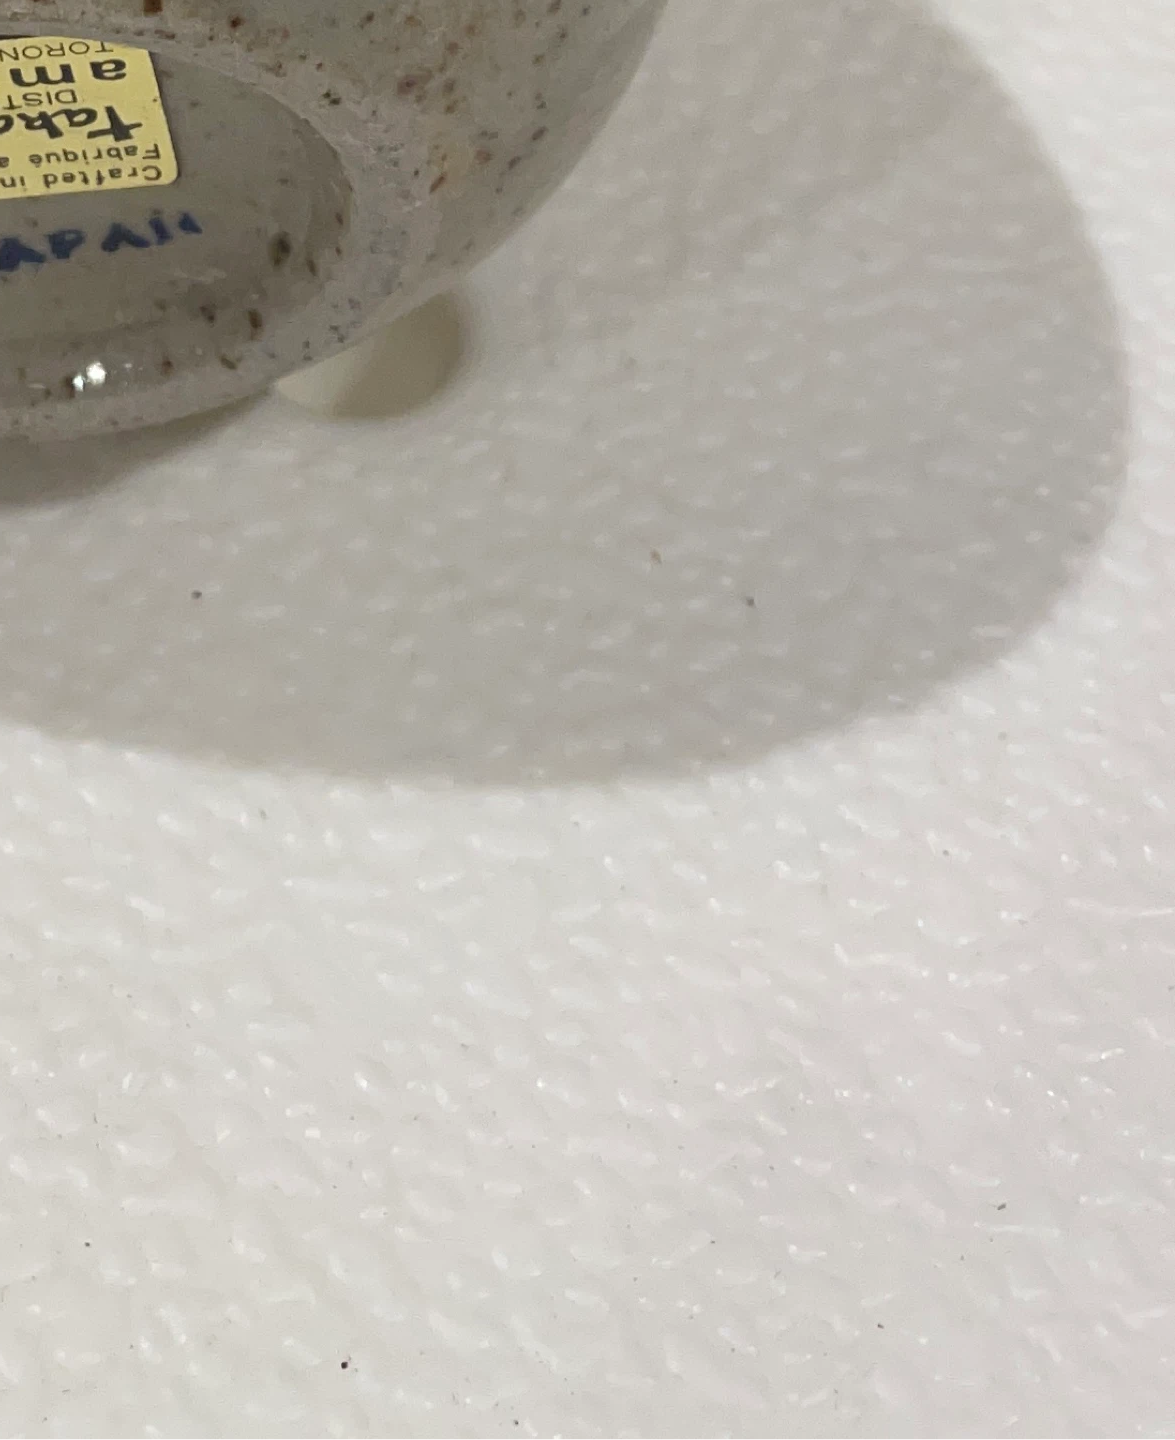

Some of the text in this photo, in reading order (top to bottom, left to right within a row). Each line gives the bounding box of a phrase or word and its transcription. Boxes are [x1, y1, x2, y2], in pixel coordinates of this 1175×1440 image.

[28, 144, 160, 168] Fabriqué
[0, 175, 25, 191] in
[42, 164, 162, 189] Crafted
